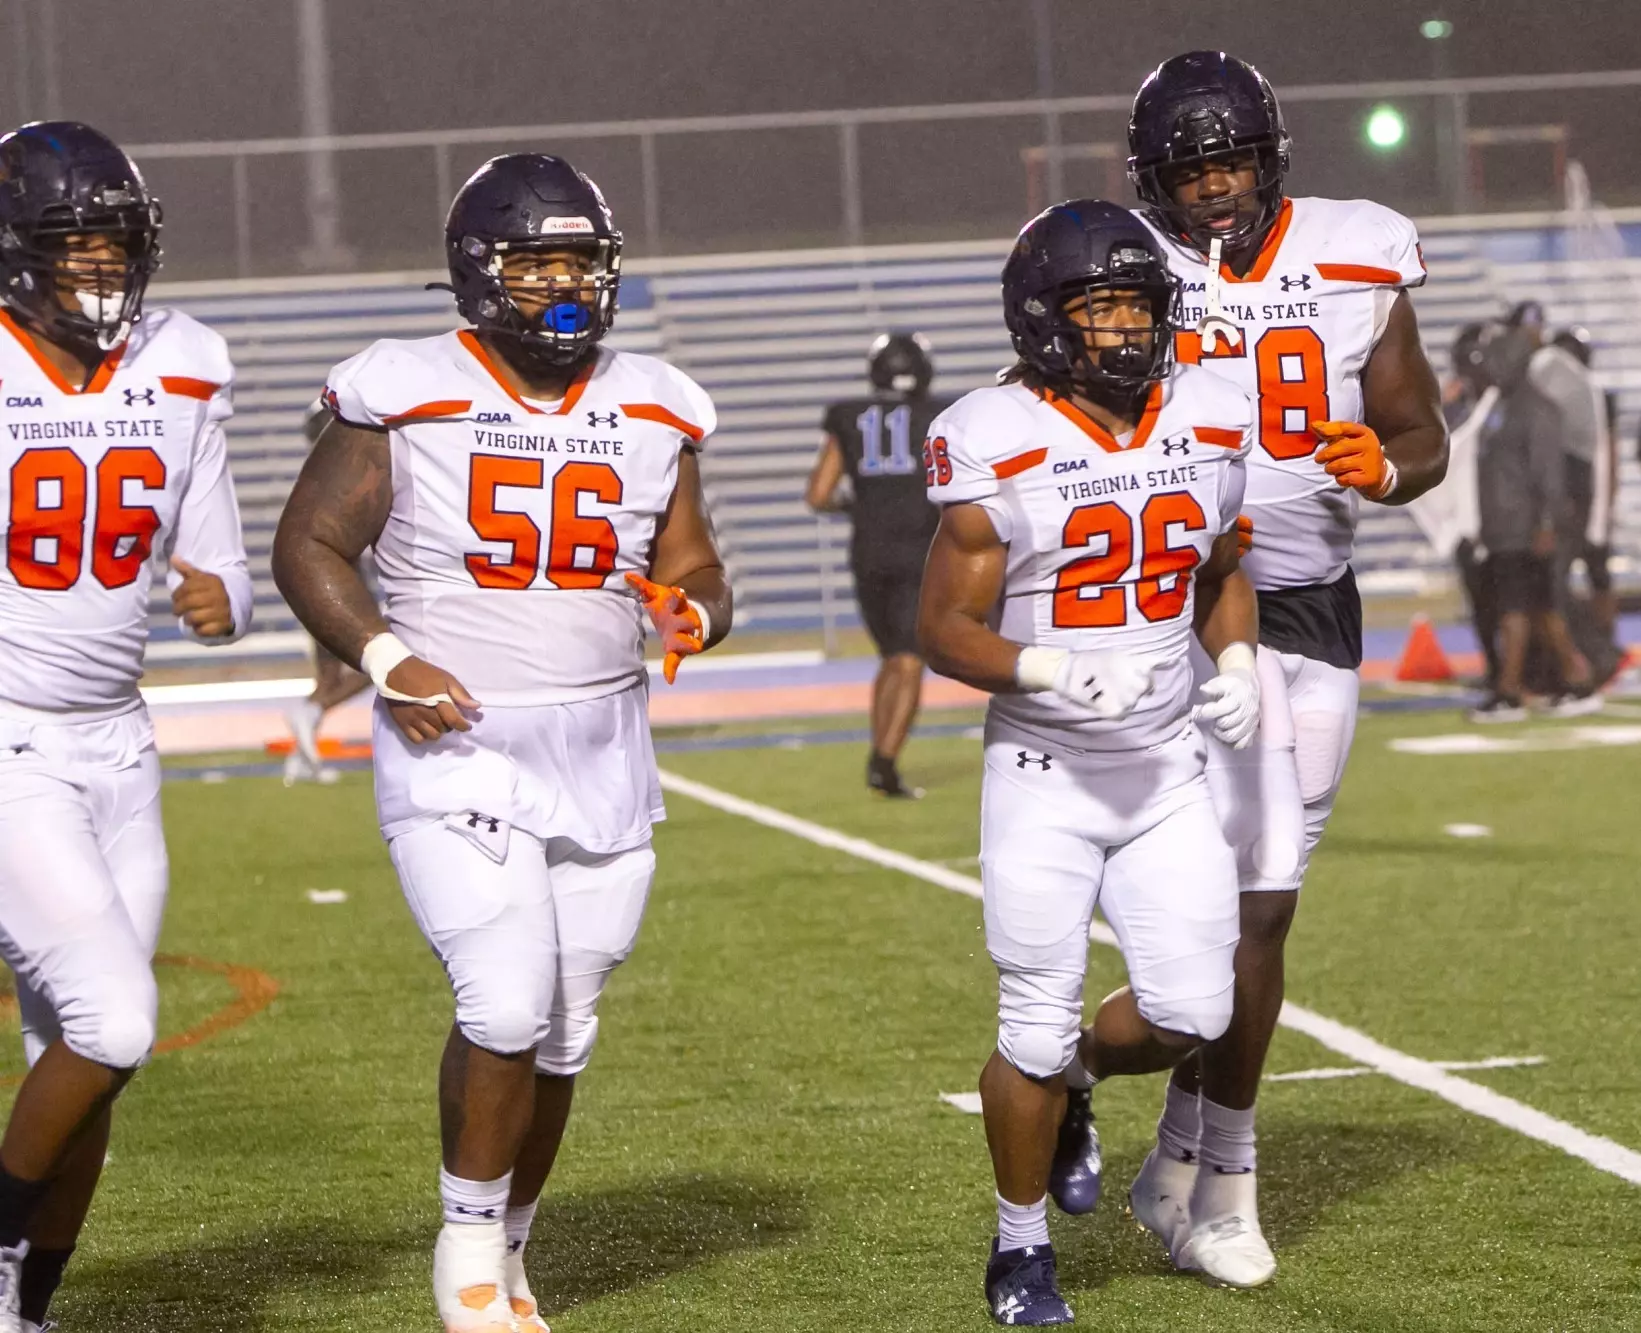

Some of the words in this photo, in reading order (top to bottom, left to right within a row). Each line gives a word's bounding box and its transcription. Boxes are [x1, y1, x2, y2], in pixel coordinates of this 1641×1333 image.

[1182, 282, 1206, 293] IAA
[1174, 304, 1256, 322] VIRIA
[1263, 302, 1320, 321] STATE
[6, 397, 43, 407] CIAA
[476, 412, 512, 423] CIAA
[7, 421, 97, 440] VIRGINIA
[105, 420, 164, 437] STATE
[856, 404, 917, 476] 11
[474, 430, 558, 453] VIRGINIA
[566, 438, 624, 456] STATE
[1053, 459, 1089, 475] CIAA
[1057, 474, 1141, 501] VIRGINIA
[1147, 465, 1198, 488] STATE
[6, 446, 167, 591] 86
[464, 452, 624, 590] 56
[1052, 490, 1206, 628] 26
